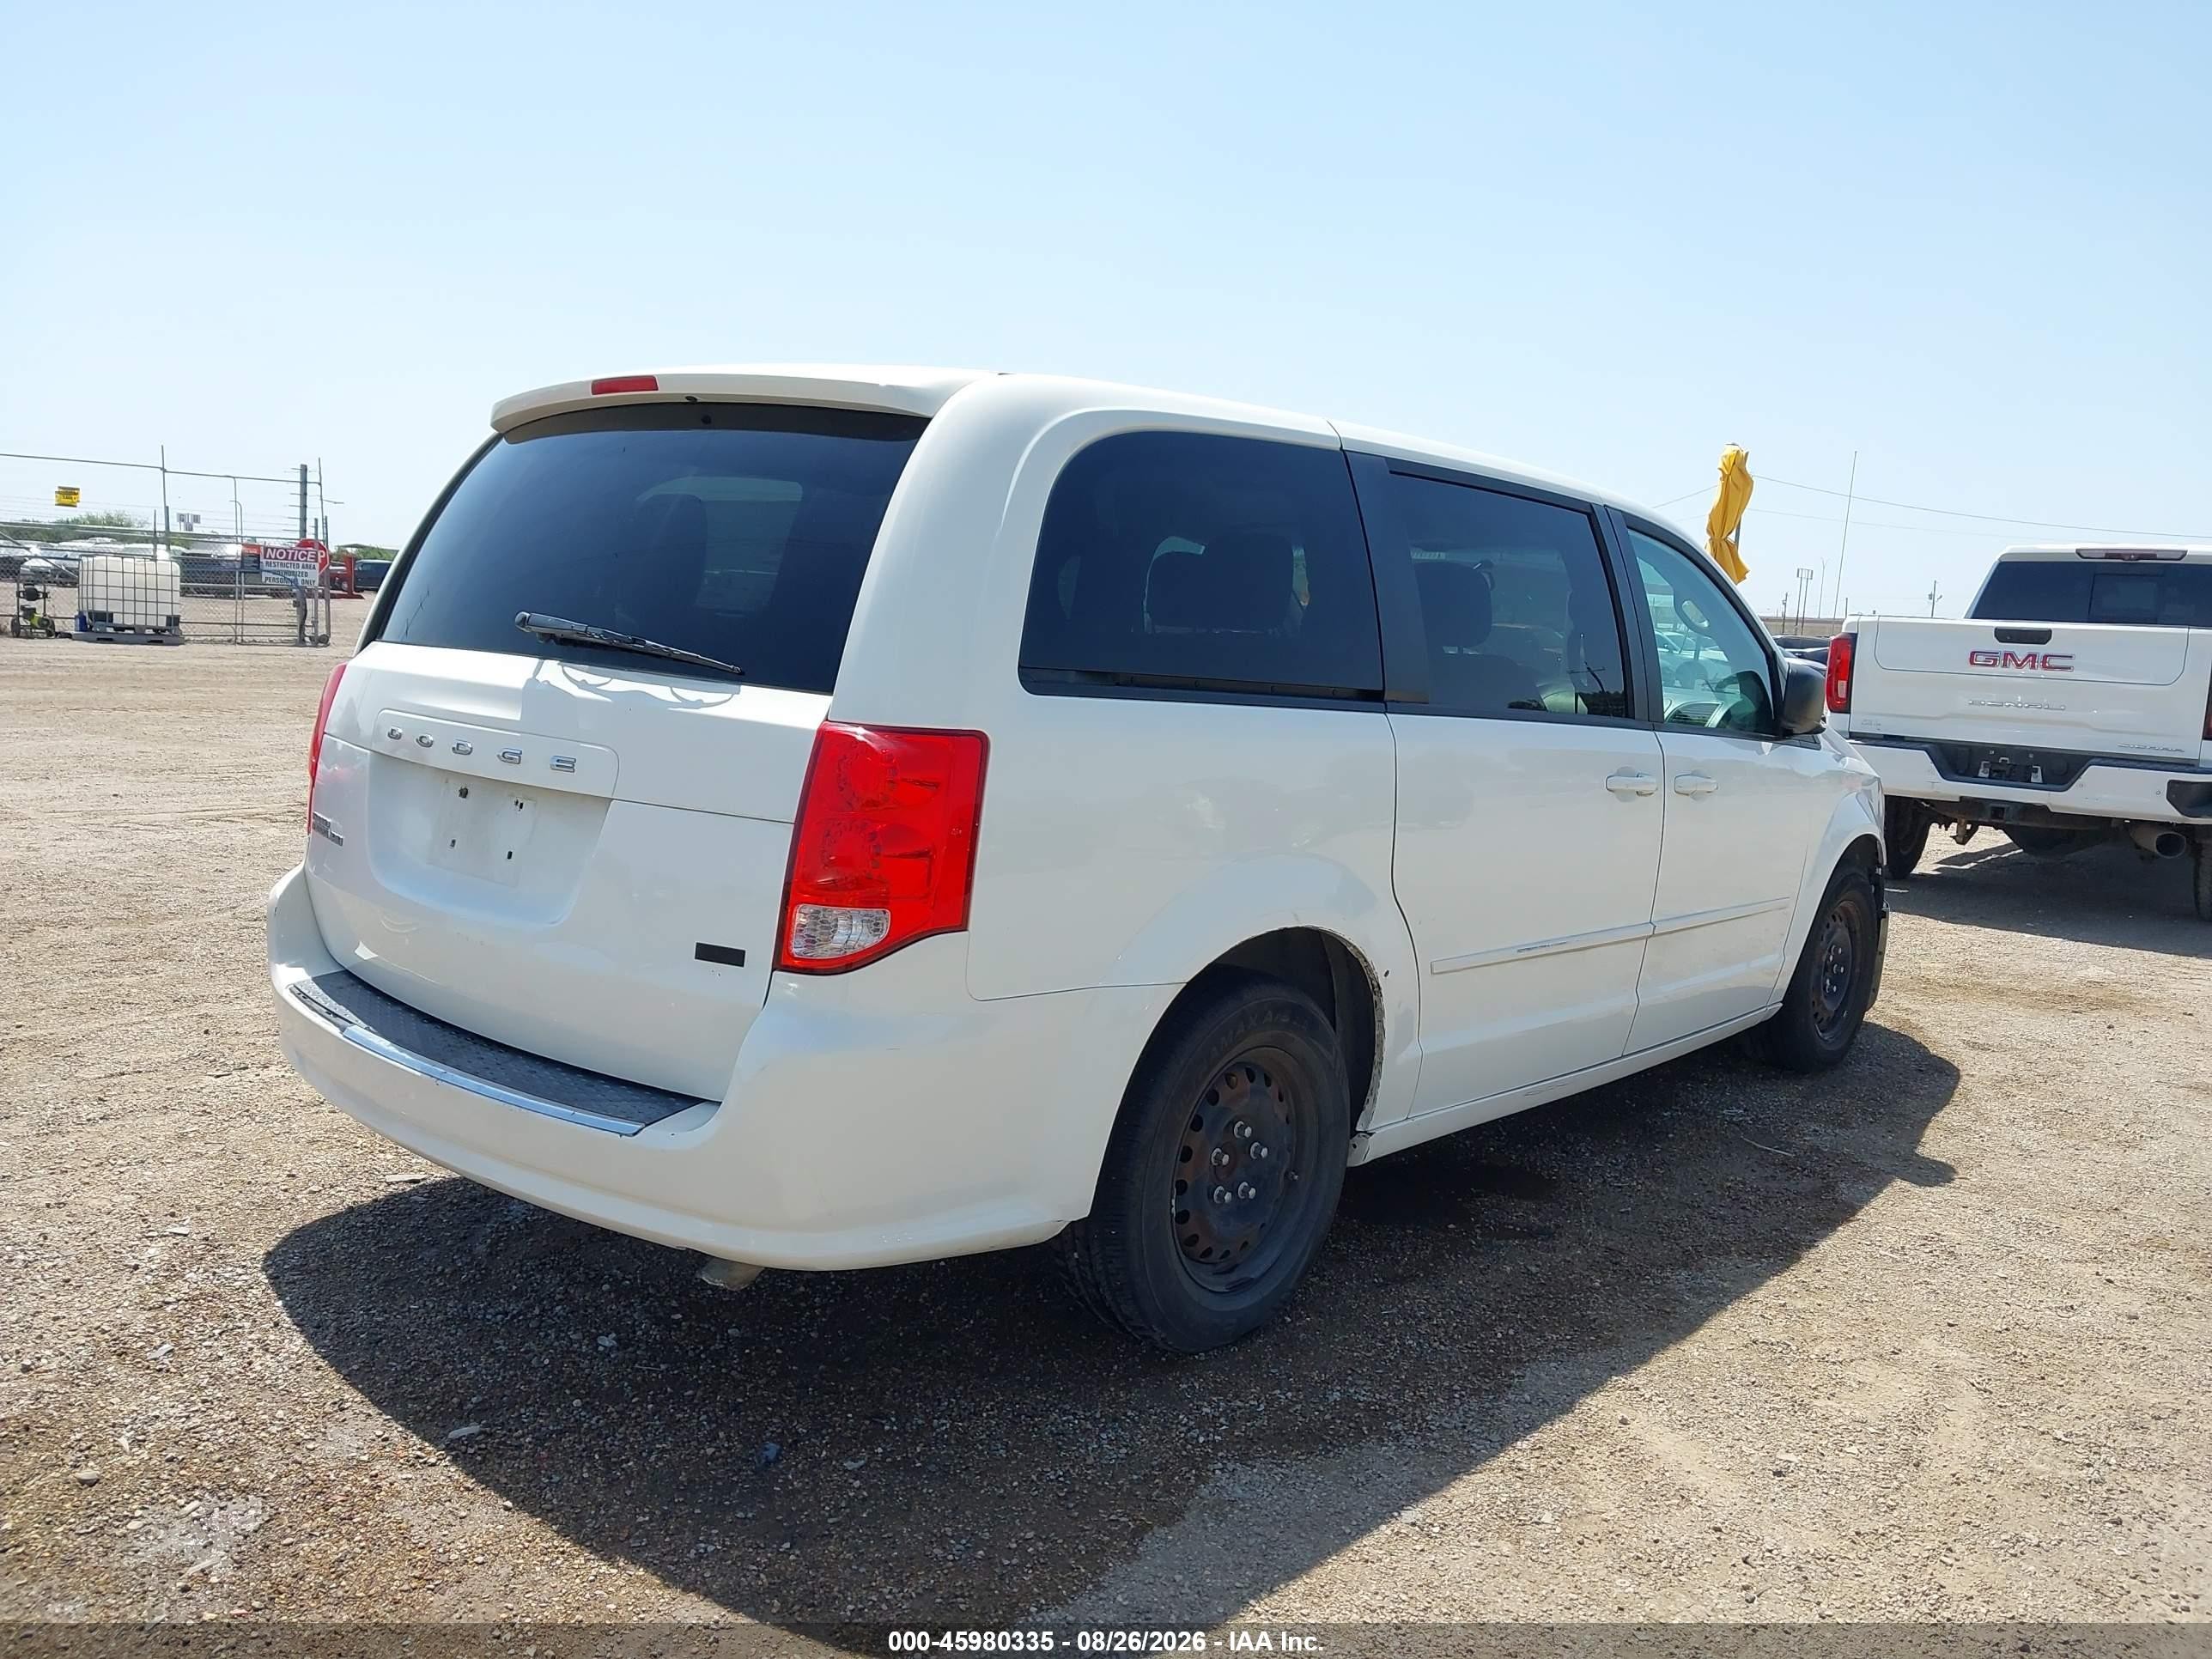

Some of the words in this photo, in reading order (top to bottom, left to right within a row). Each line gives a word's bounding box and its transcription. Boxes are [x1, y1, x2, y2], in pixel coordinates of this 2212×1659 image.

[265, 548, 317, 562] NOTICE
[265, 560, 301, 569] RESTRICTED
[264, 576, 298, 586] PERSON
[1968, 650, 2076, 672] GMC
[387, 726, 577, 773] DODGE
